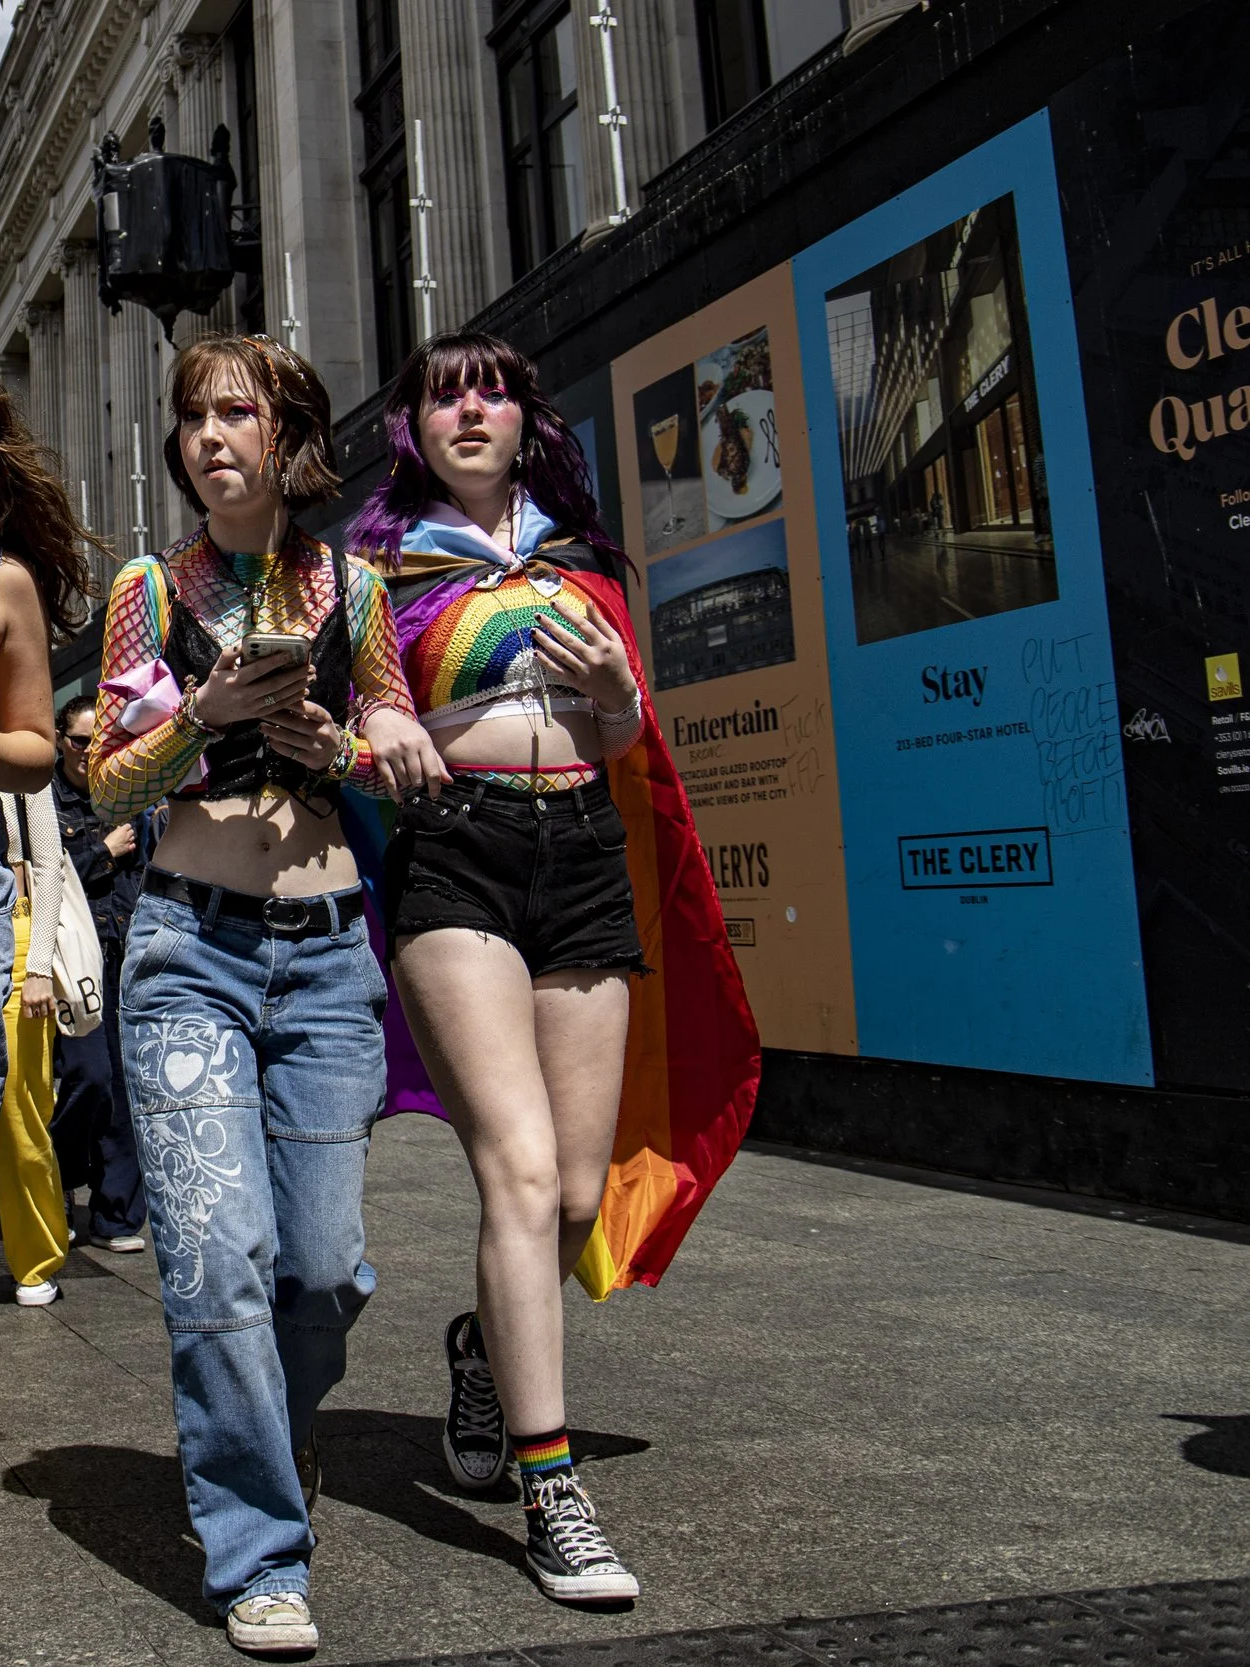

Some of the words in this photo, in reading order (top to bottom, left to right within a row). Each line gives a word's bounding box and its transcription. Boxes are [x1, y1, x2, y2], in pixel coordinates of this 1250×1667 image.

[1190, 256, 1215, 277] IT'S
[1217, 245, 1243, 266] ALL
[979, 355, 1010, 397] CLERY
[1021, 632, 1093, 684] PUT
[921, 664, 988, 707] Stay
[1211, 682, 1241, 698] savills
[673, 699, 779, 747] Entertain
[1030, 682, 1118, 746] PEOPLE
[1211, 713, 1233, 726] Retail
[936, 726, 993, 745] FOUR-STAR
[996, 722, 1031, 737] HOTEL
[679, 768, 718, 781] ECTACULAR
[719, 763, 748, 776] GLAZED
[749, 758, 787, 772] ROOFTOP
[1037, 729, 1120, 786] BEFORE
[685, 781, 722, 795] ESTAURANT
[724, 779, 740, 790] AND
[741, 777, 756, 788] BAR
[757, 774, 779, 785] WITH
[716, 794, 739, 806] VIEWS
[740, 792, 751, 803] OF
[752, 790, 767, 801] THE
[768, 788, 788, 800] CITY
[702, 842, 770, 888] LERYS
[908, 848, 952, 876] THE
[960, 842, 1038, 874] CLERY
[77, 976, 102, 1015] B
